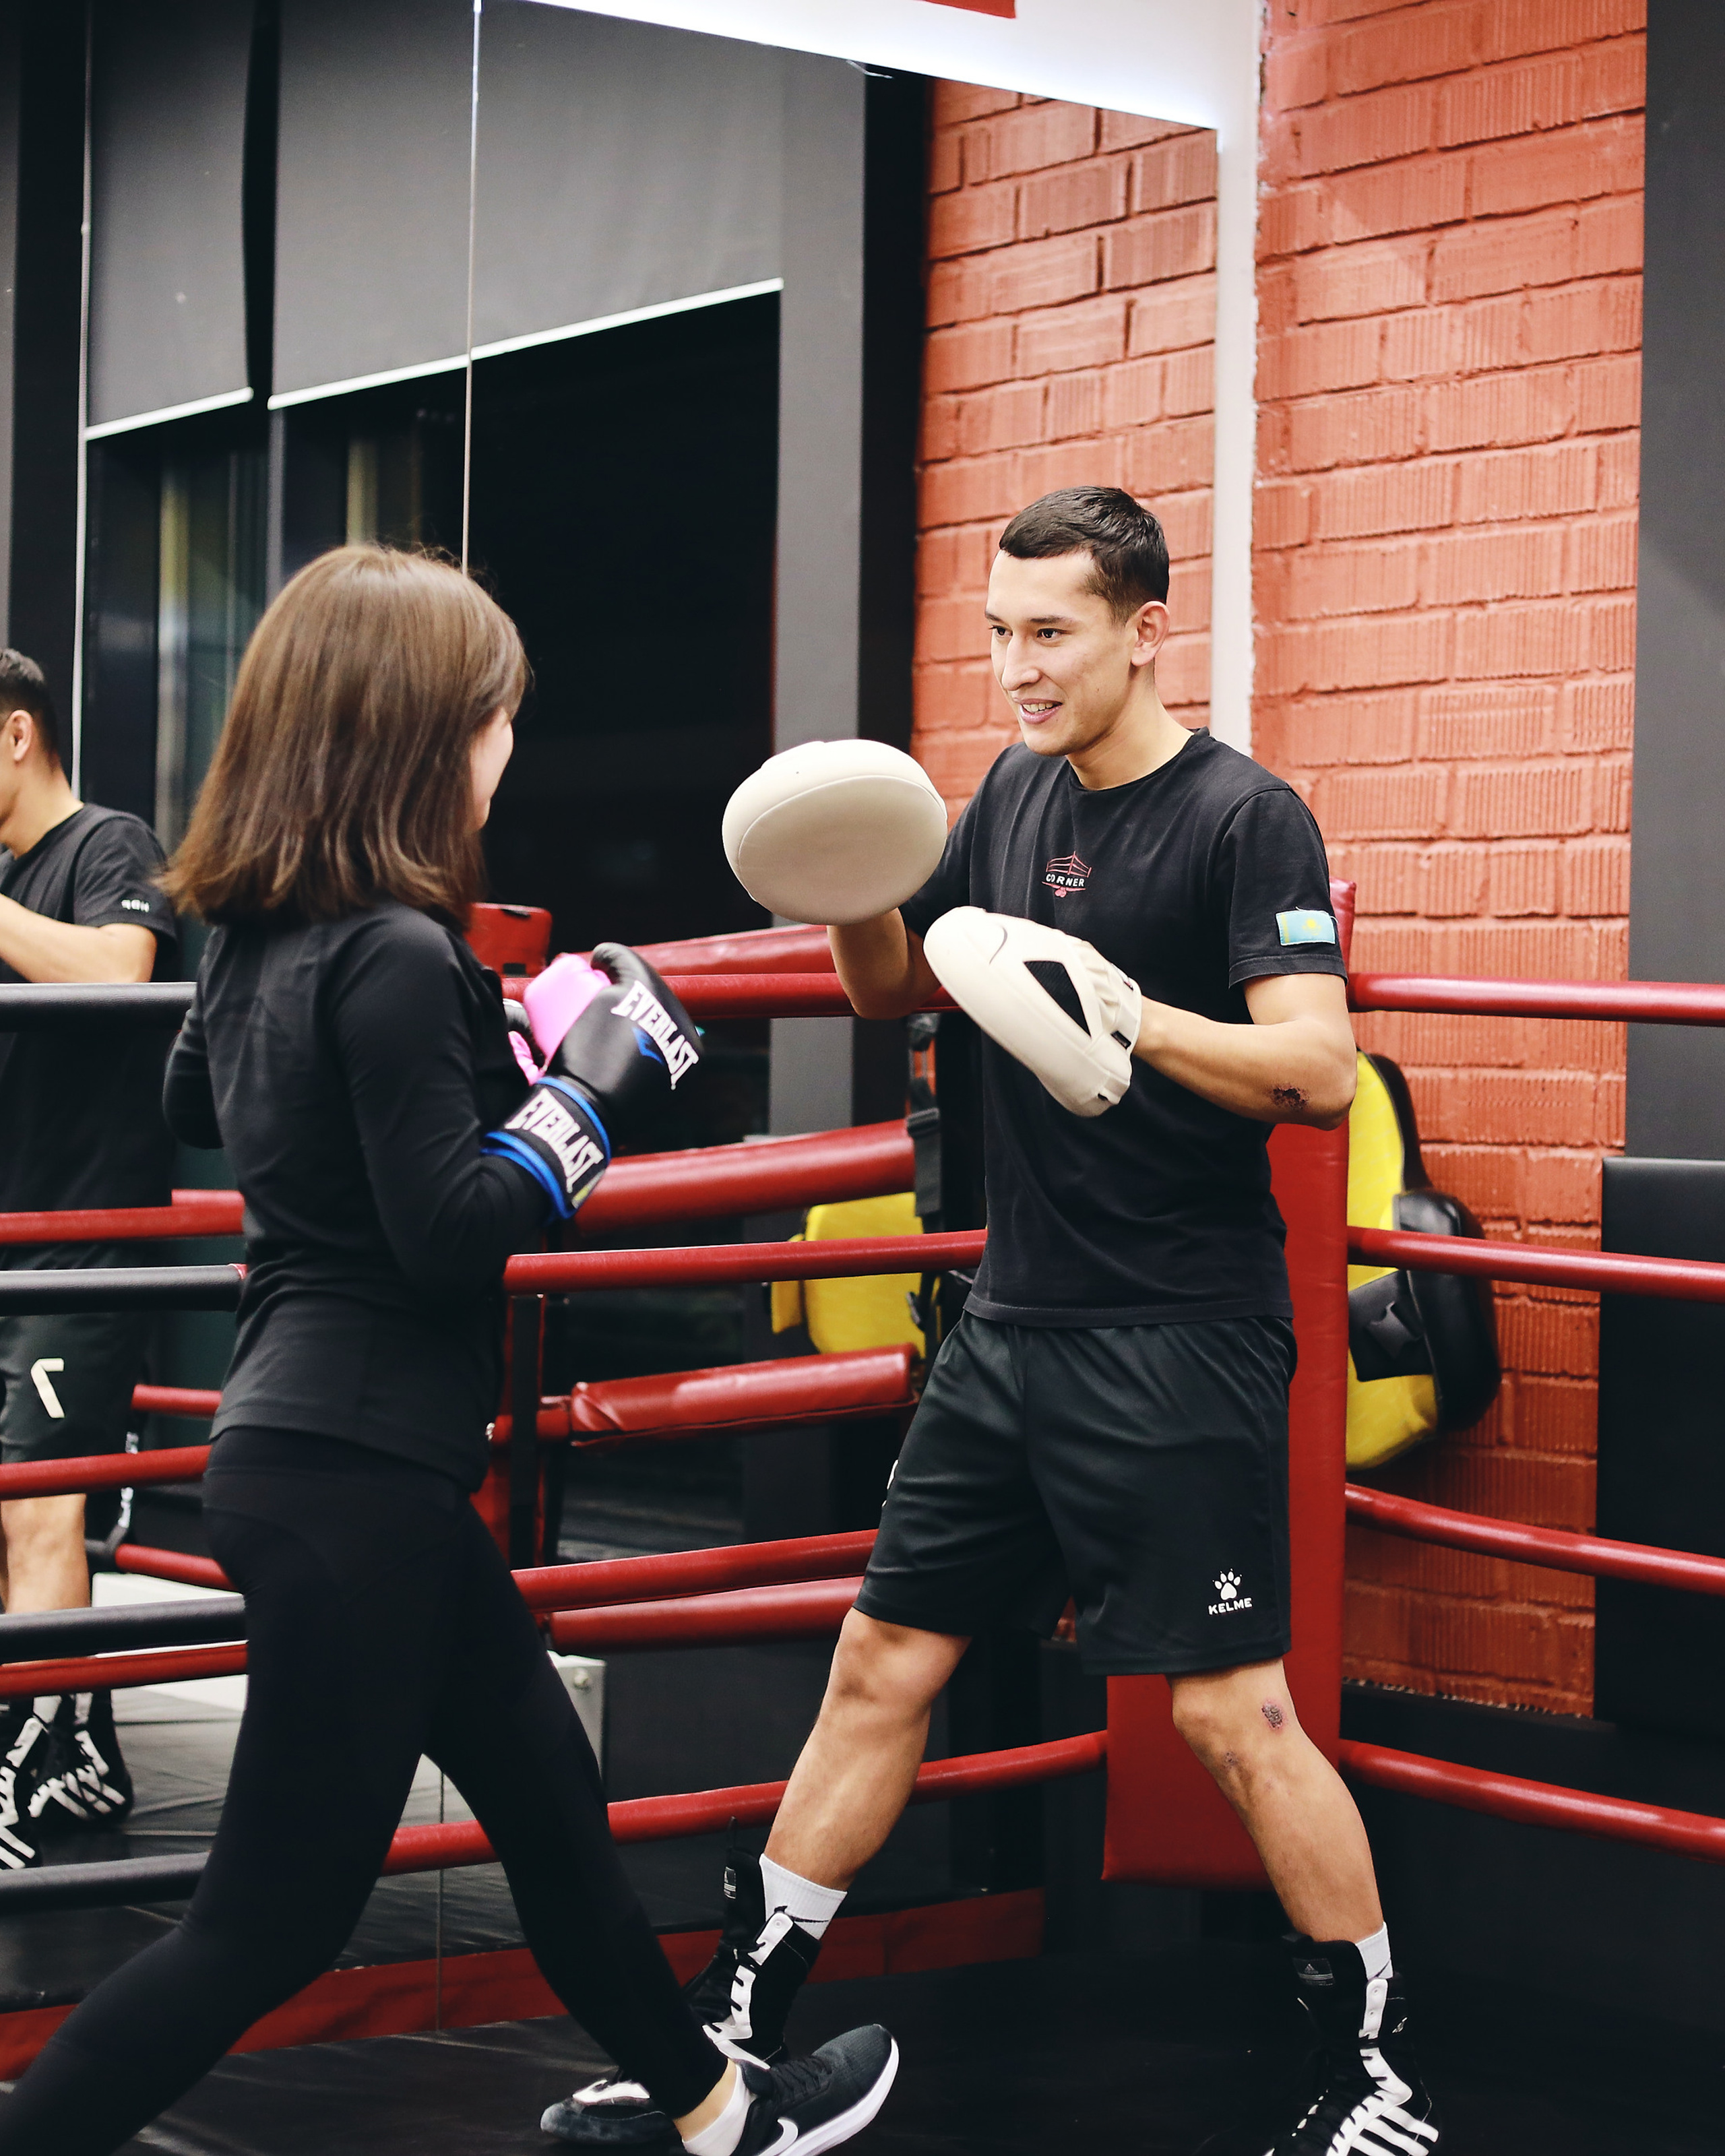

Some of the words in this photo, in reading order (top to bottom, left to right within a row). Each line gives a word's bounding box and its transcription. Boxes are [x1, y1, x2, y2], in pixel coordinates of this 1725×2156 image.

[1046, 873, 1085, 887] CORNER
[610, 980, 699, 1091] EVERLAST
[505, 1087, 604, 1193] EVERLAST
[1208, 1597, 1253, 1615] KELME
